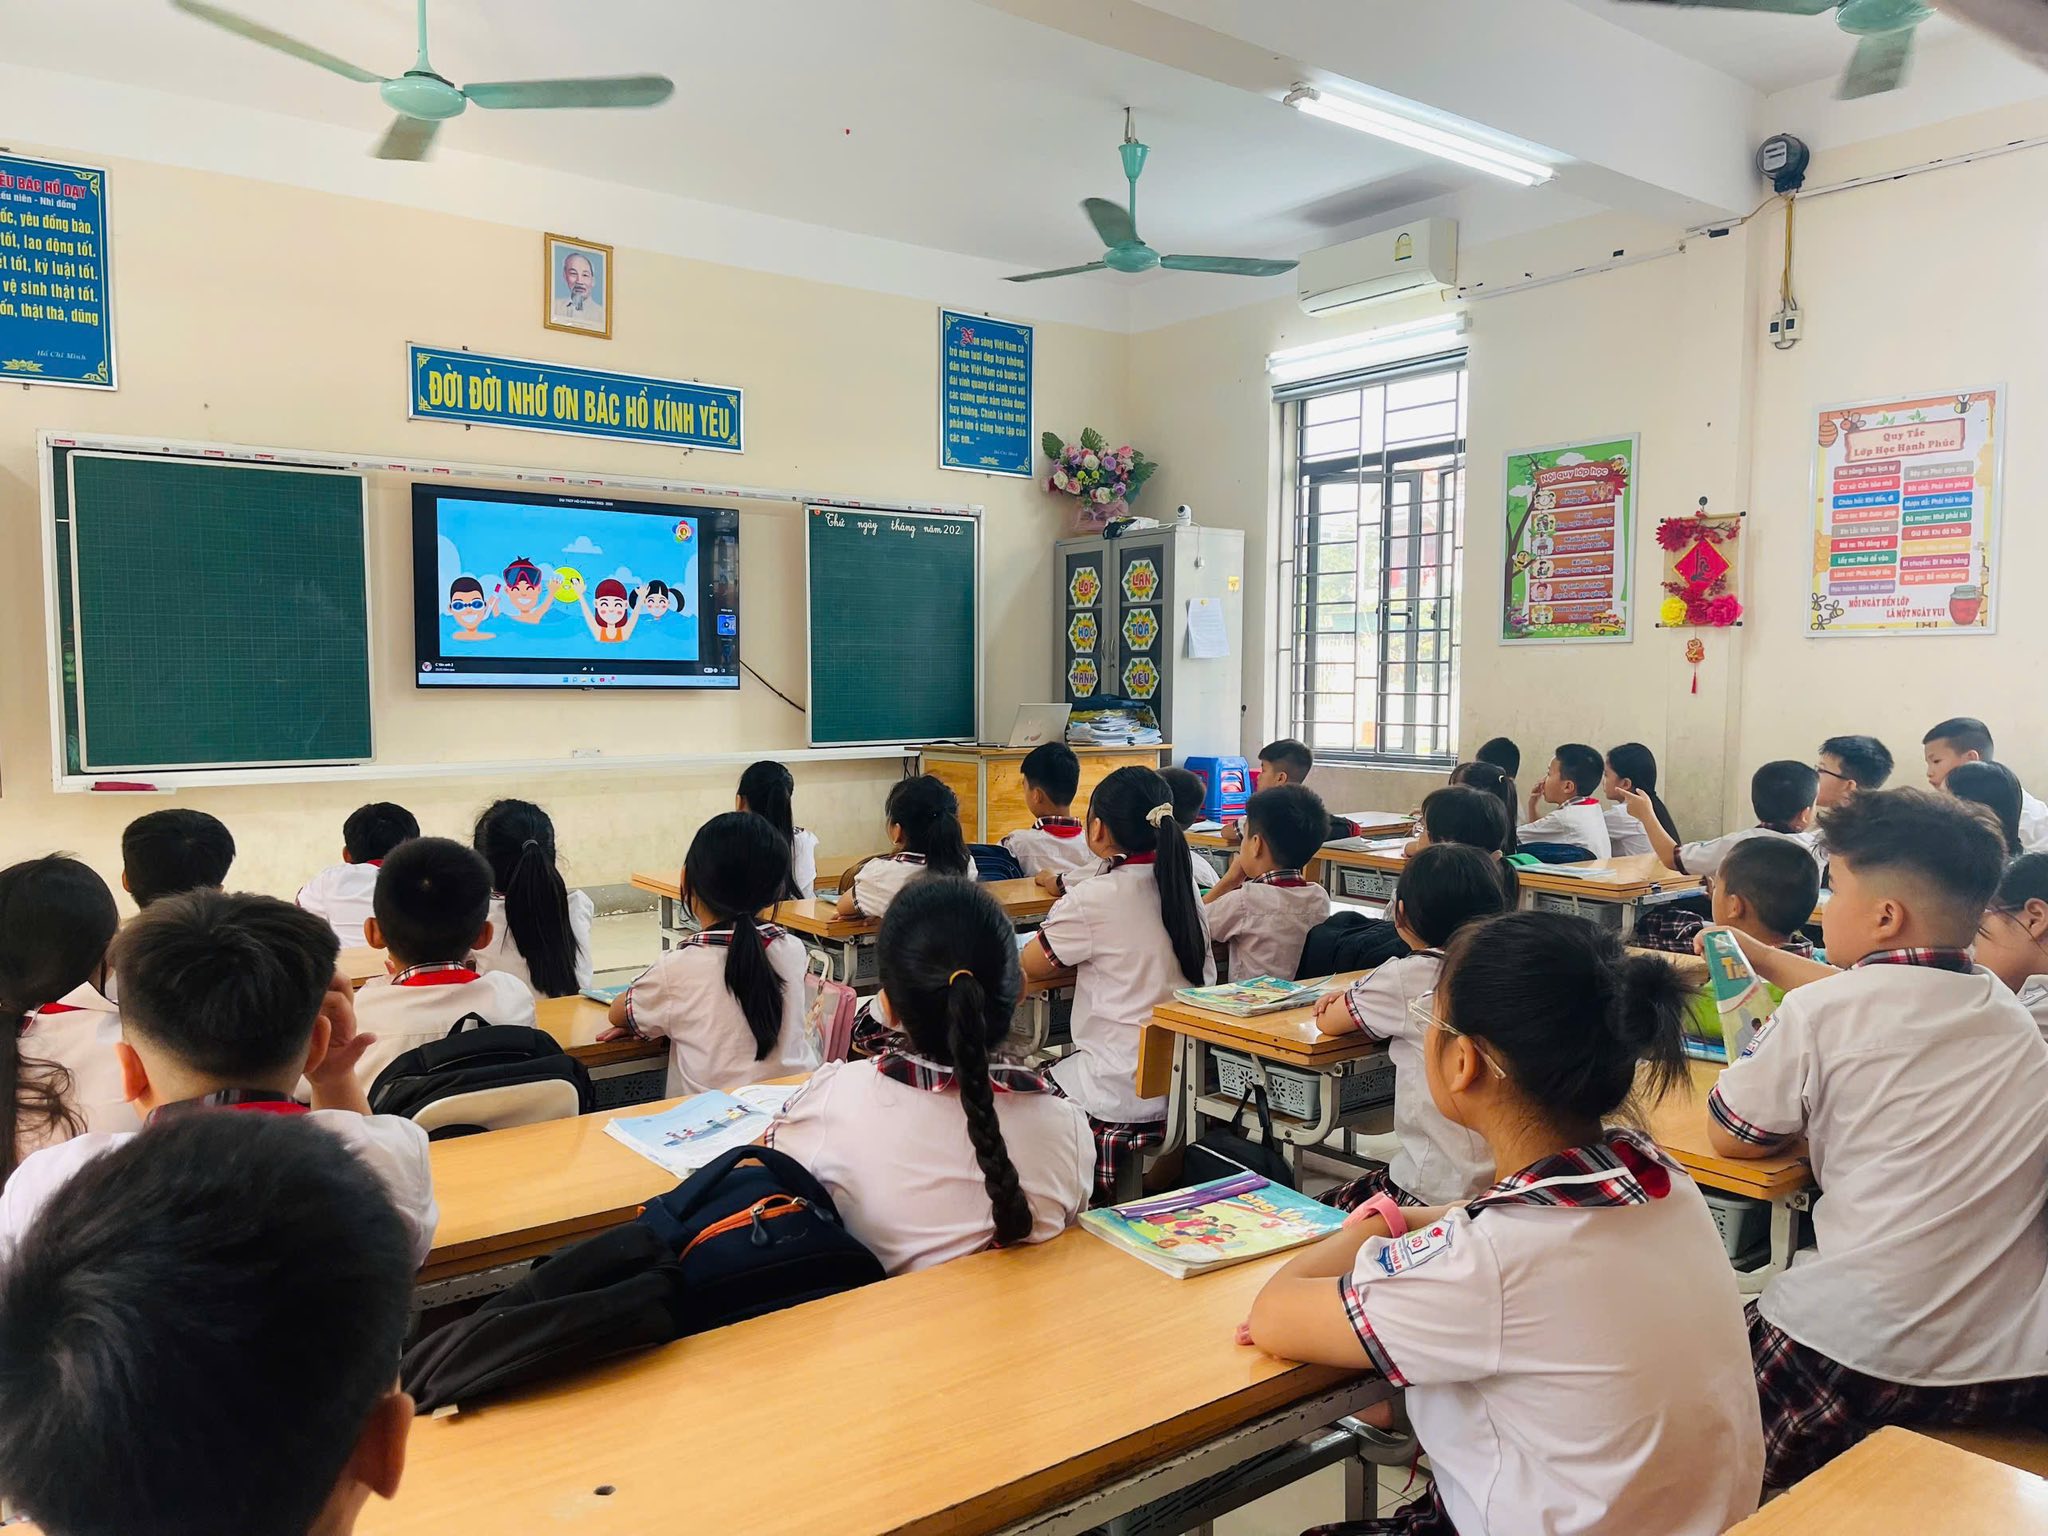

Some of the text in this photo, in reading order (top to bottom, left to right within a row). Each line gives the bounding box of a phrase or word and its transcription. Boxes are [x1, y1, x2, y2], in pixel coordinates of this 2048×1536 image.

[14, 193, 32, 203] niên
[17, 175, 41, 192] BÁC
[44, 179, 61, 195] HỒ
[63, 184, 86, 200] DẠY
[0, 206, 94, 235] ốc, yêu đồng bào.
[1, 231, 96, 257] tốt, lao động tốt.
[11, 254, 31, 273] tốt,
[35, 258, 48, 275] kỷ
[52, 261, 75, 279] luật
[79, 263, 98, 280] tốt.
[3, 278, 16, 296] vệ
[21, 281, 47, 296] sinh
[51, 284, 74, 302] thật
[0, 298, 98, 326] ốn, thật thà, dũng
[429, 364, 729, 439] ĐỜI ĐỜI NHỚ ƠN BÁC HỒ KÍNH YÊU
[1883, 428, 1925, 441] Quy Tắc
[1854, 439, 1955, 457] Lớp Học Hạnh Phúc
[1541, 466, 1608, 484] Nội quy lớp học
[857, 519, 878, 535] ngày
[891, 518, 916, 538] tháng
[924, 525, 942, 534] năm
[1933, 607, 1945, 616] VUI
